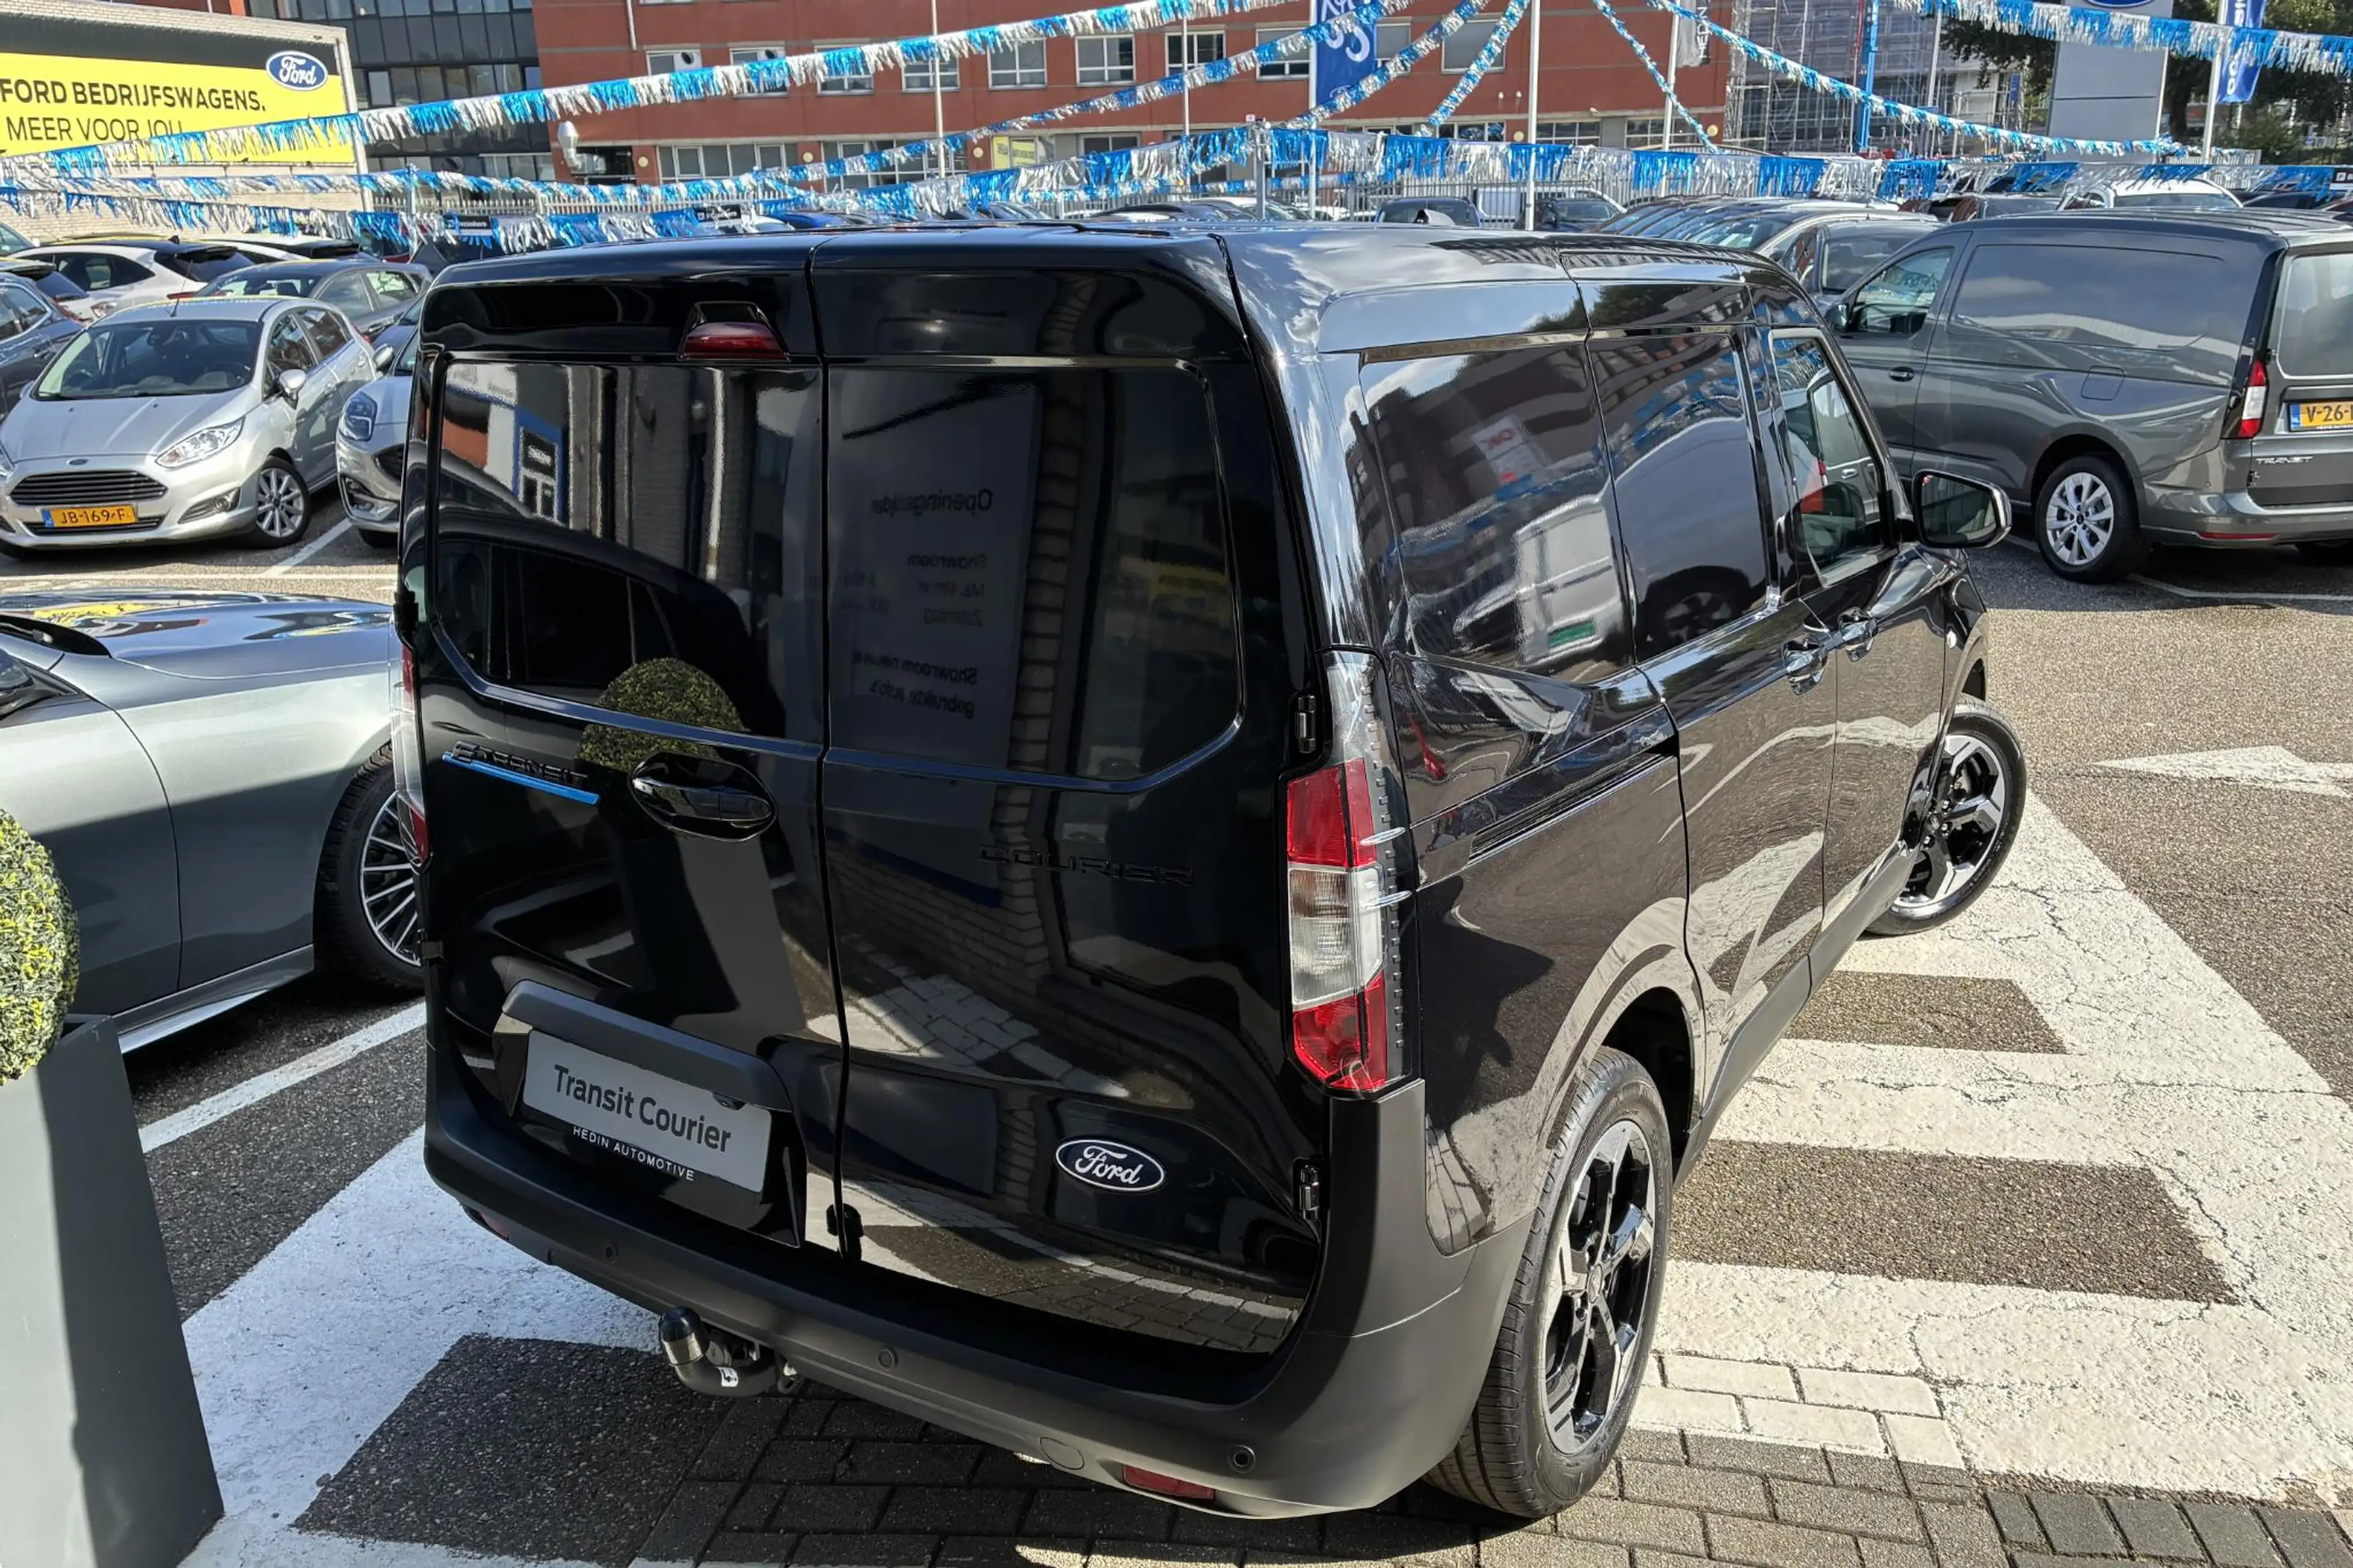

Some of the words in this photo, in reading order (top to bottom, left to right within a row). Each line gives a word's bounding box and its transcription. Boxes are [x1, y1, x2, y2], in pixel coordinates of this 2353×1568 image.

[279, 56, 316, 85] Ford
[0, 78, 67, 103] FORD
[72, 81, 266, 112] BEDRIJFSWAGENS.
[6, 116, 72, 141] MEER
[77, 118, 140, 142] VOOR
[2306, 404, 2353, 423] V-26-
[61, 508, 126, 525] JB-169-F
[977, 844, 1195, 887] COURIER
[554, 1064, 634, 1118] Transit
[639, 1097, 731, 1153] Courier
[573, 1126, 609, 1148] HEDIN
[613, 1142, 694, 1181] AUTOMOTIVE
[1075, 1145, 1143, 1184] Ford
